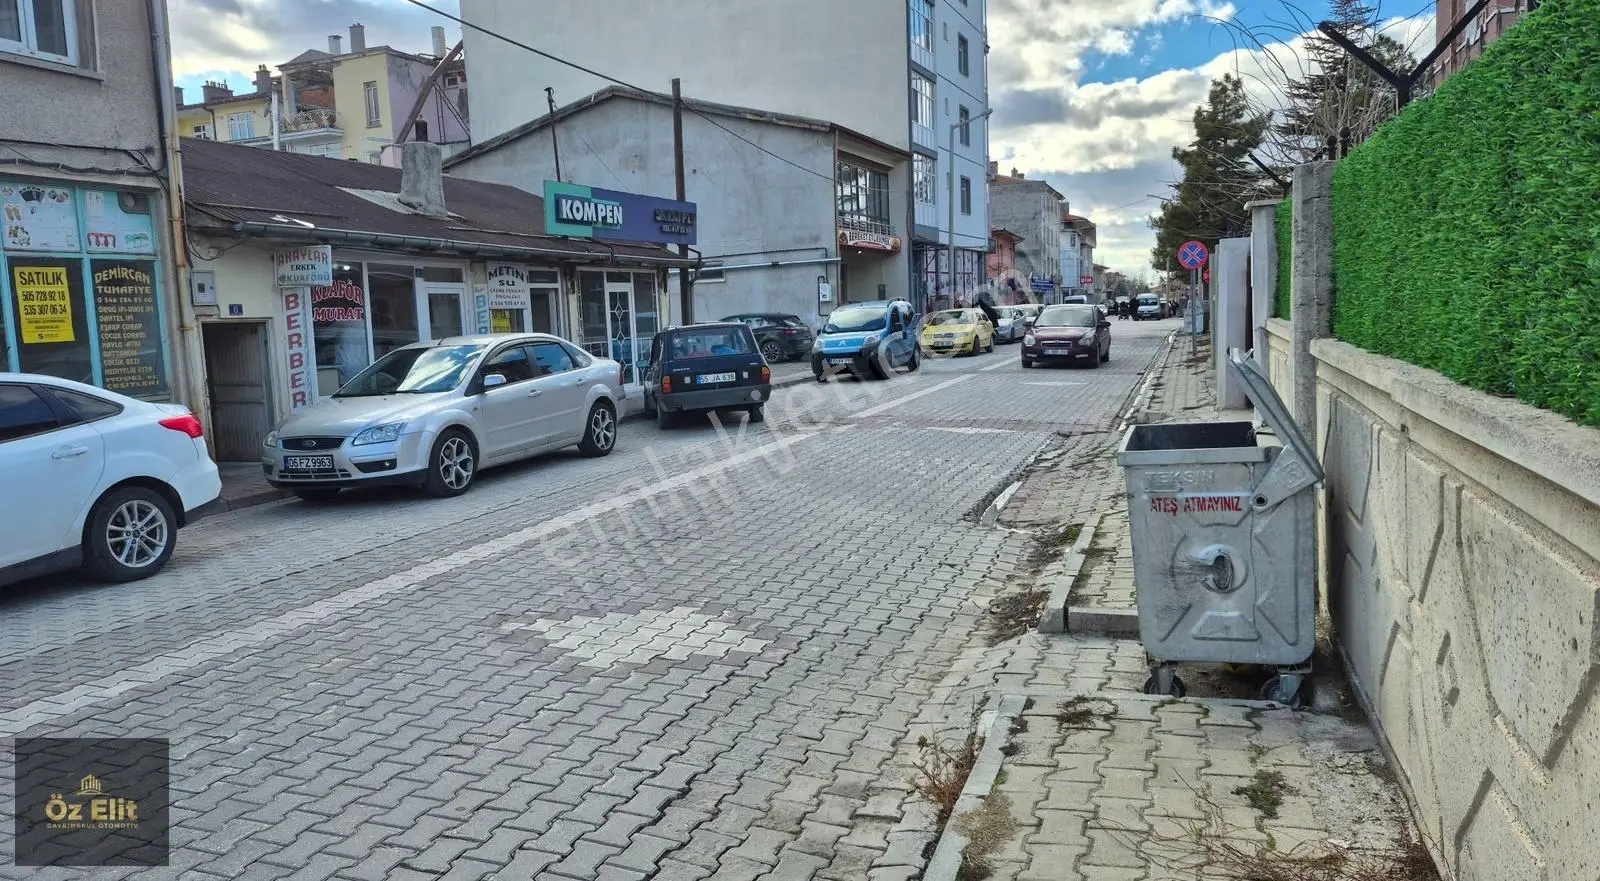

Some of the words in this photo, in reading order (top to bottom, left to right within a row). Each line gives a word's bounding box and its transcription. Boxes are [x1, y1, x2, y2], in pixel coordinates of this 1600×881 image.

[561, 199, 623, 225] KOMPEN
[278, 249, 328, 266] AKAYLAR
[290, 263, 317, 272] ERKEK
[18, 271, 64, 286] SATILIK
[312, 279, 363, 305] KUAFÖR
[313, 307, 365, 322] MURAT
[285, 293, 306, 408] BERBER
[712, 375, 721, 383] JA
[1151, 496, 1178, 516] ATEŞ
[1184, 495, 1242, 513] ATMAYINIZ
